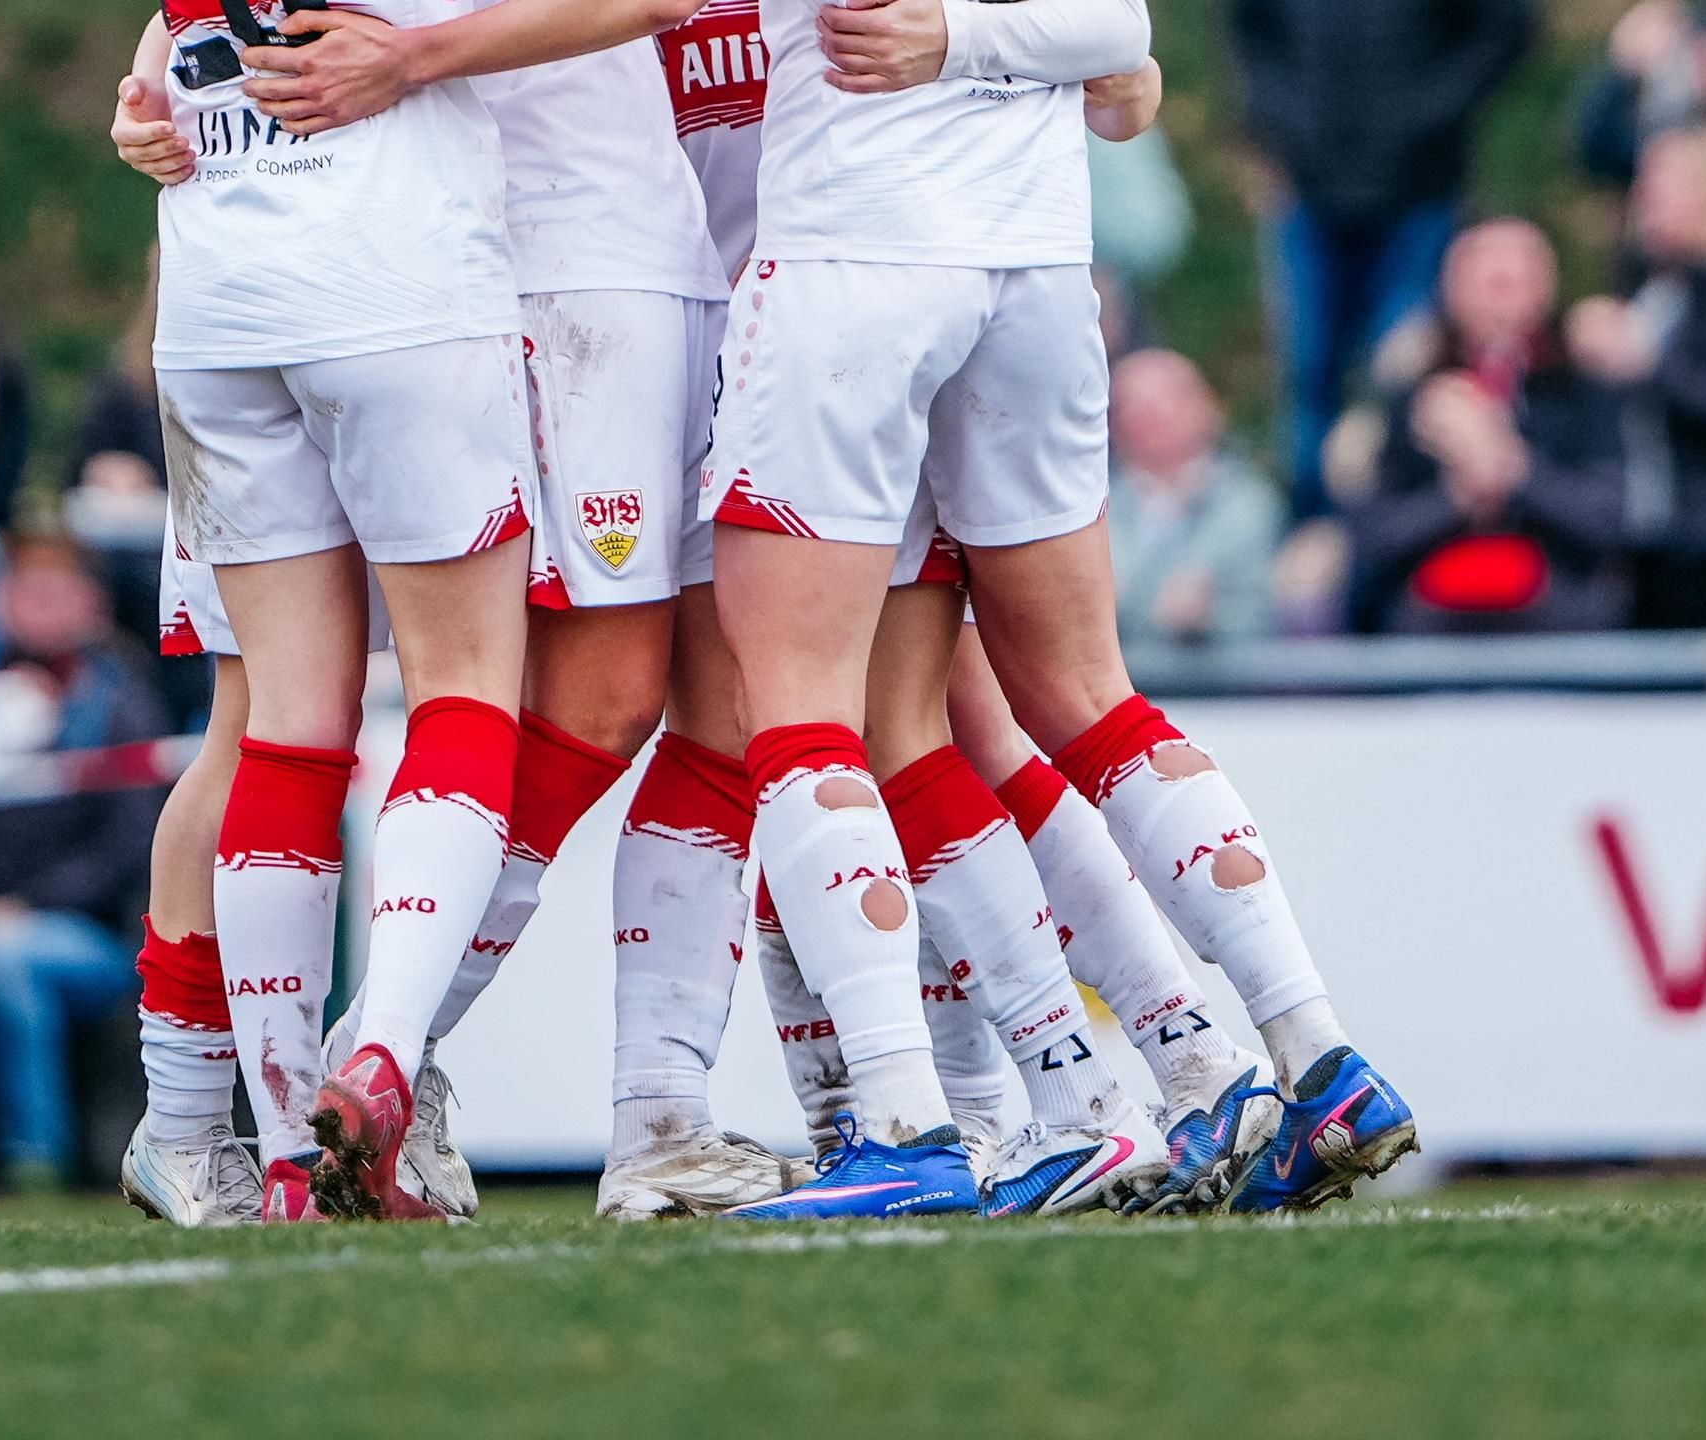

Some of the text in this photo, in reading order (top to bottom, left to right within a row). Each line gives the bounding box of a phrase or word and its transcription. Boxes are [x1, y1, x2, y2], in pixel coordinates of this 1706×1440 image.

[681, 31, 766, 95] Alli
[256, 153, 335, 177] COMPANY
[1173, 824, 1258, 881] JAKO
[612, 926, 650, 947] KO
[228, 975, 302, 997] JAKO
[777, 1018, 837, 1043] VfB
